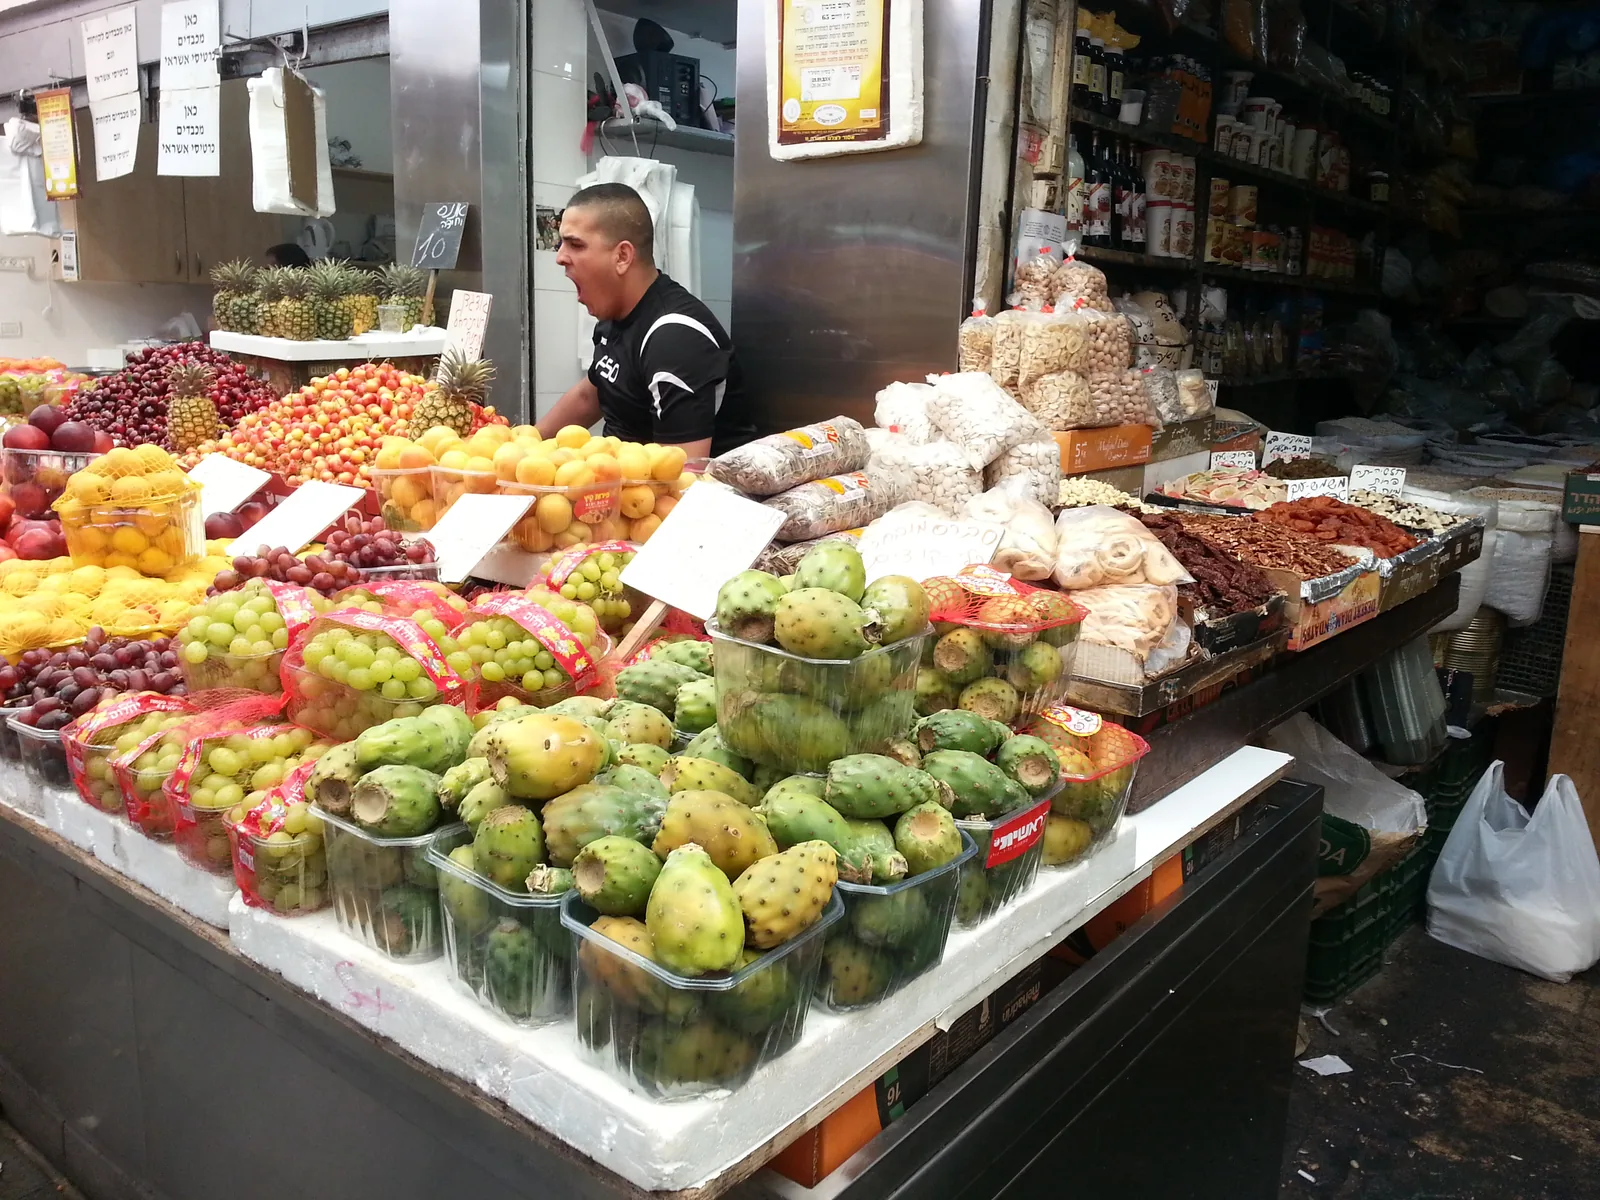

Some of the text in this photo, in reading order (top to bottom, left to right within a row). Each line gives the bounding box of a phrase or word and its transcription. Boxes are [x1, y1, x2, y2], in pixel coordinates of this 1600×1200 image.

[184, 14, 197, 29] כאן
[177, 33, 205, 46] מכבדים
[165, 51, 215, 66] כרטיסי אשראי
[184, 105, 198, 119] כאן
[176, 125, 205, 135] מכבדים
[162, 143, 215, 154] כרטיסי אשראי
[415, 233, 446, 267] 10
[1075, 443, 1082, 458] 5
[999, 811, 1049, 850] ראשית
